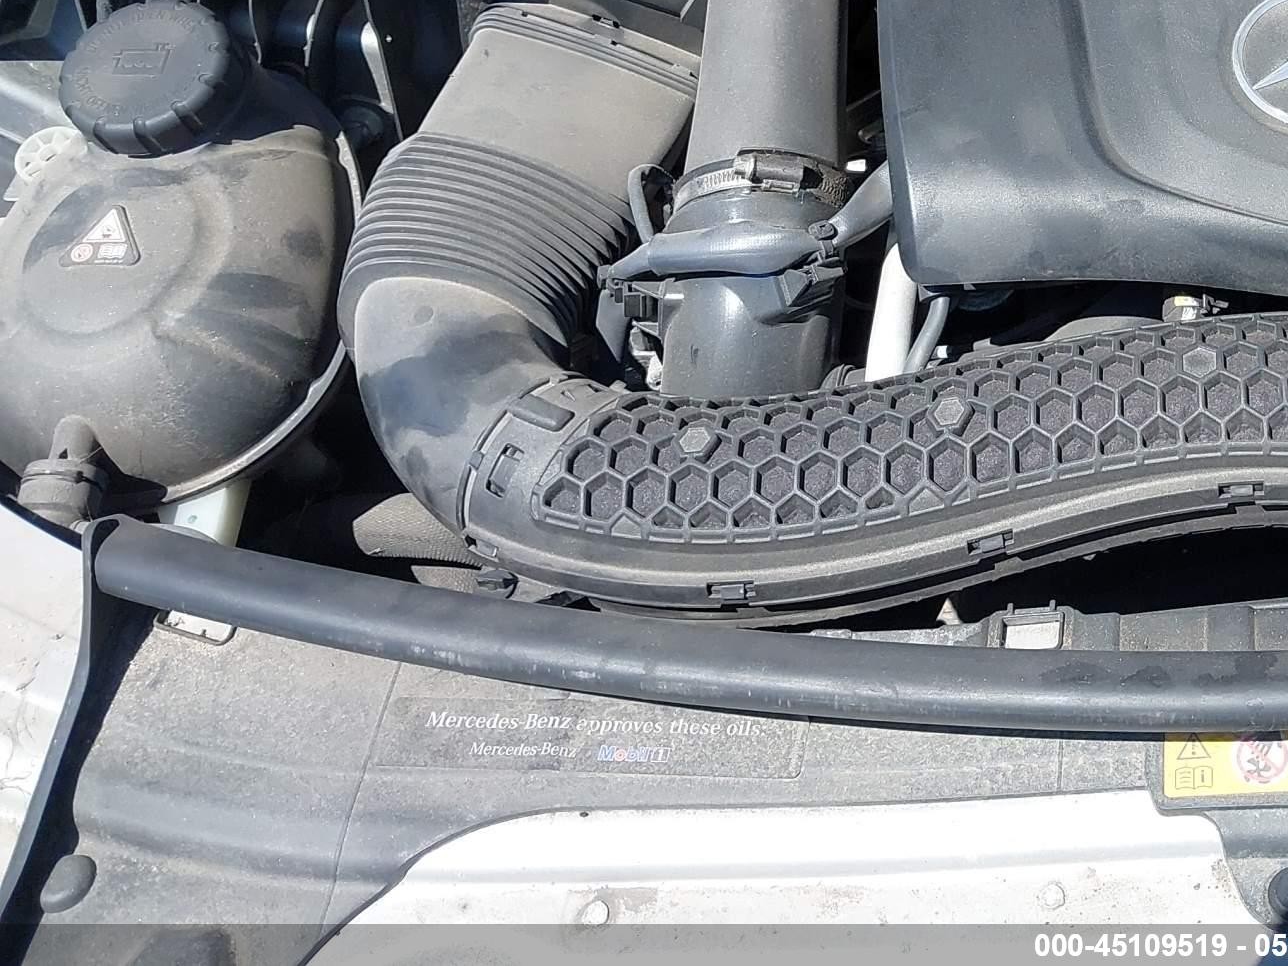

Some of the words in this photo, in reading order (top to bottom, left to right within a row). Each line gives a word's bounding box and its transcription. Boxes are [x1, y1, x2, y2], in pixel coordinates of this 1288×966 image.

[424, 711, 572, 730] Mercedes-Benz
[576, 718, 664, 735] approves
[669, 718, 721, 735] these
[468, 742, 577, 758] Mercedes-Benz
[597, 745, 652, 762] Mobil
